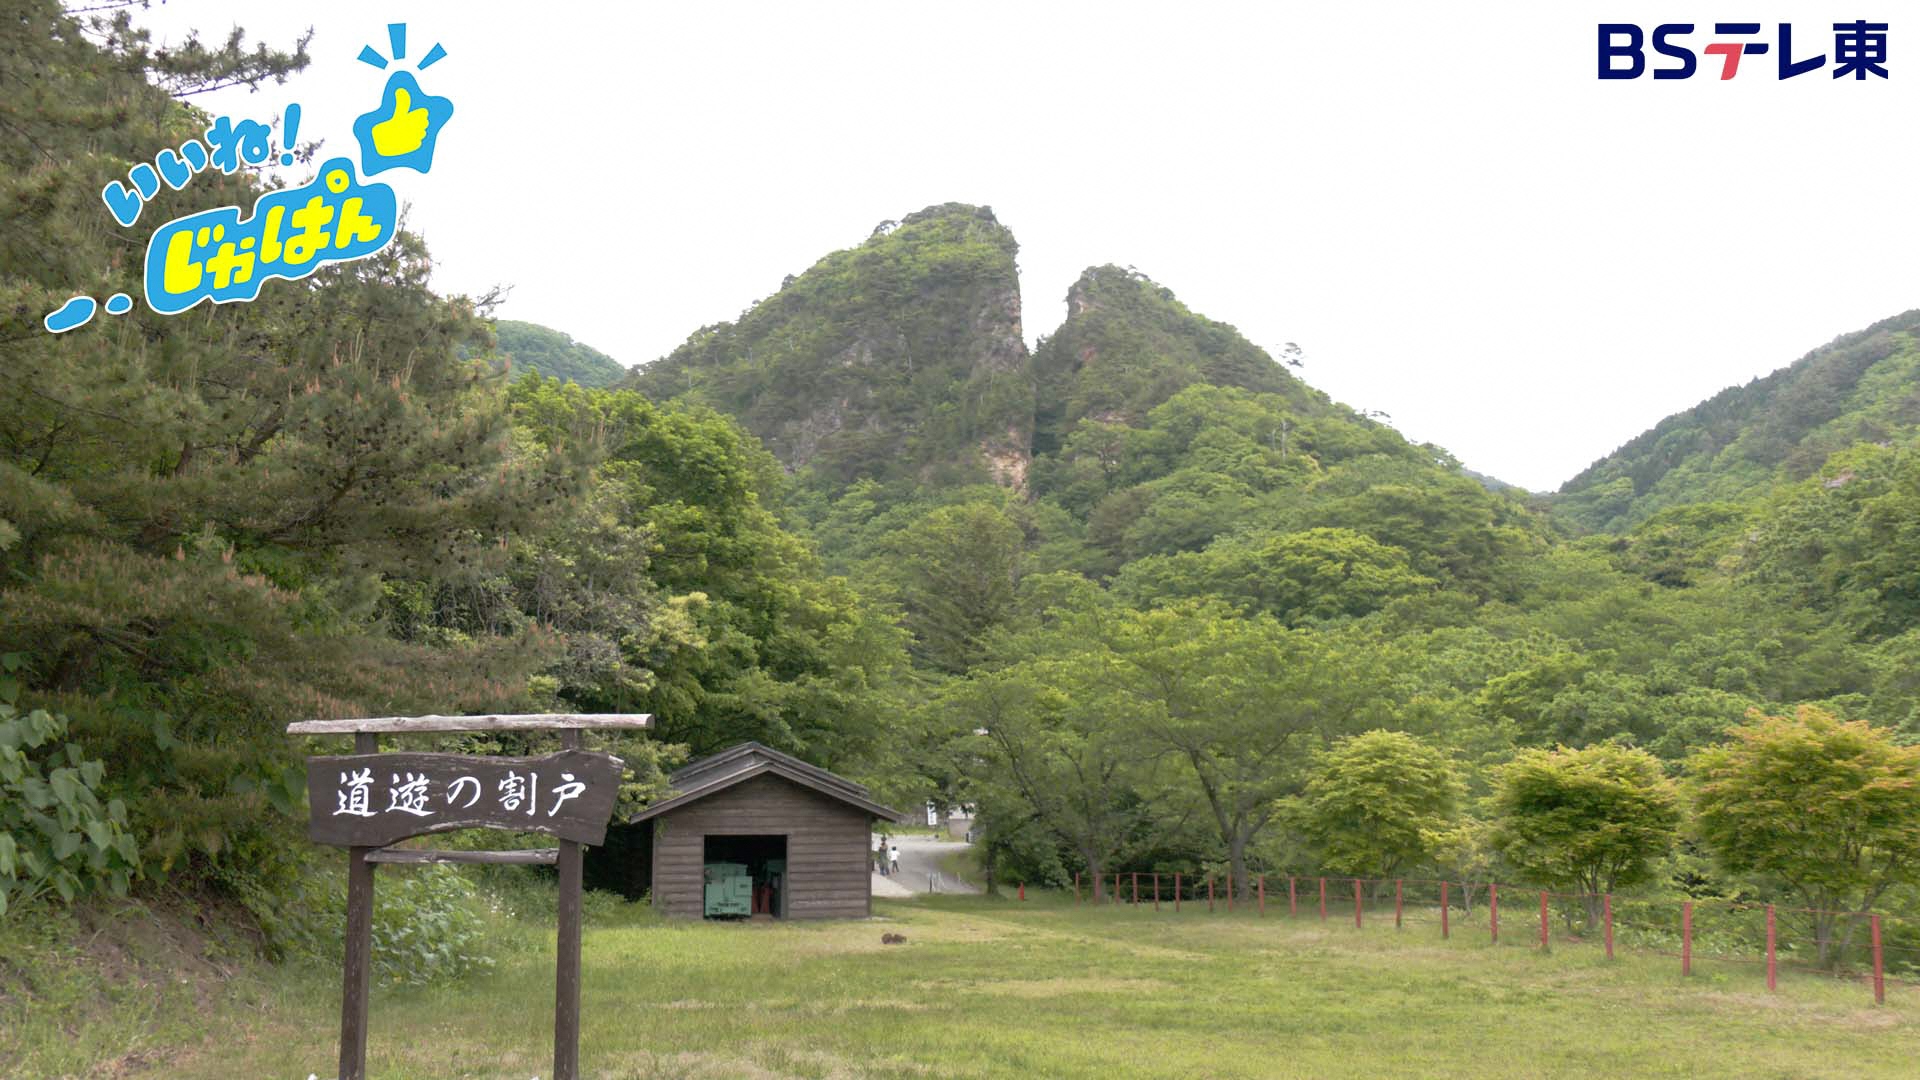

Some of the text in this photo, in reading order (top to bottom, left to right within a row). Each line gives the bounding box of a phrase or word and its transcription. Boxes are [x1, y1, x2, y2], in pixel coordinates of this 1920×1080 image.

[333, 768, 586, 817] 道遊の割戸
